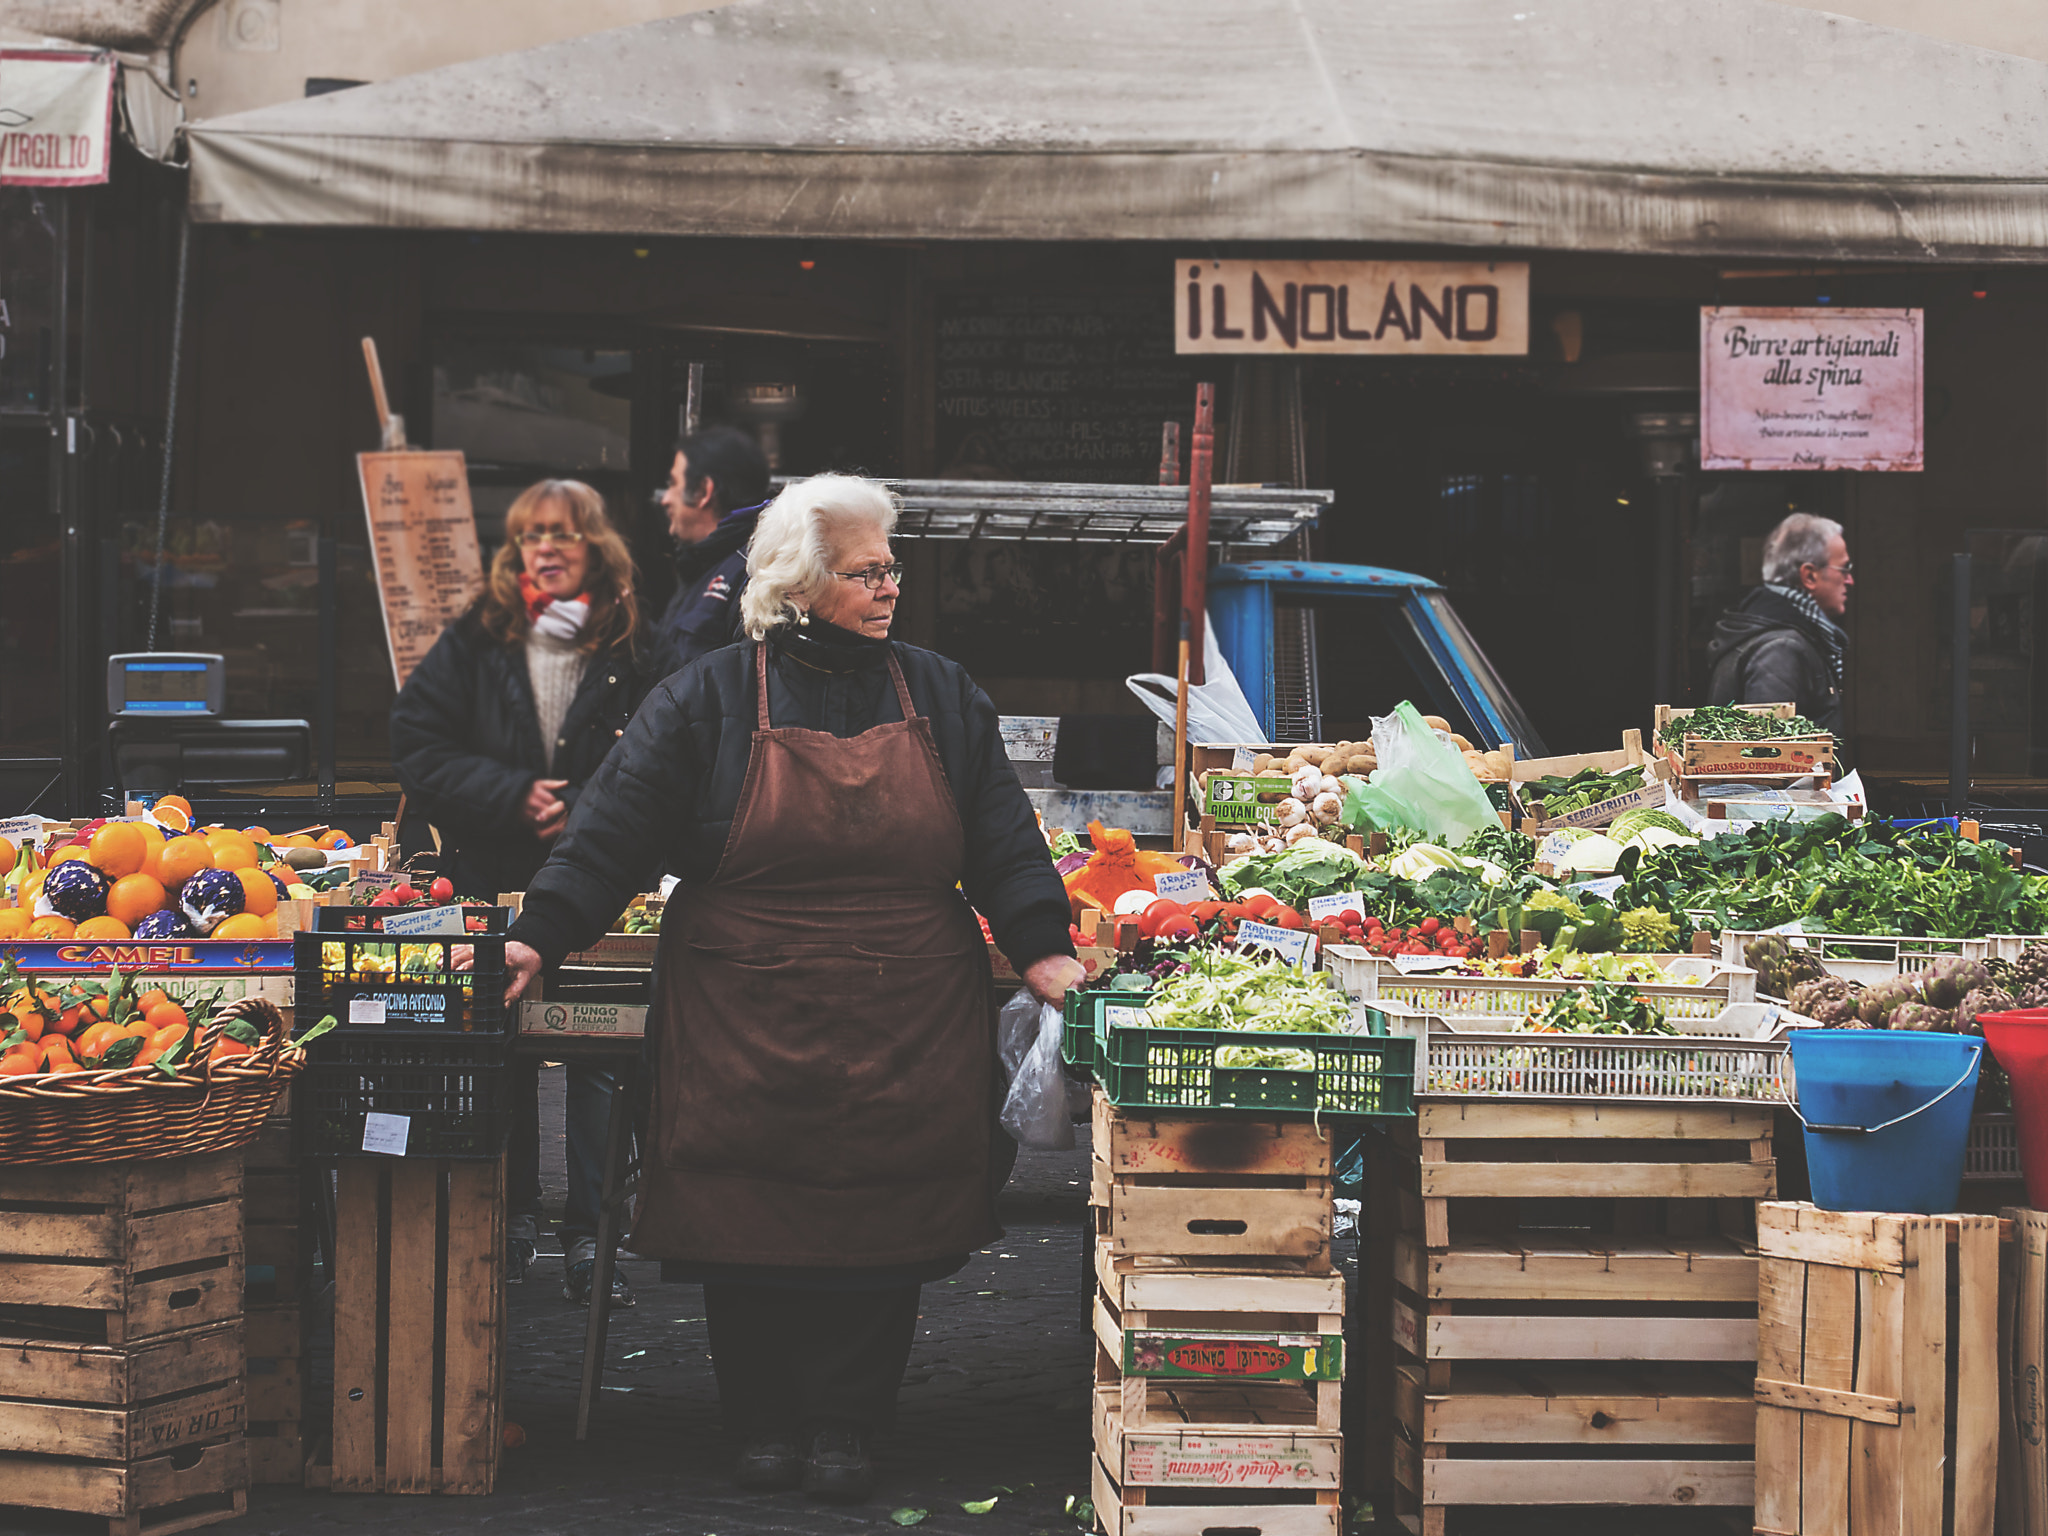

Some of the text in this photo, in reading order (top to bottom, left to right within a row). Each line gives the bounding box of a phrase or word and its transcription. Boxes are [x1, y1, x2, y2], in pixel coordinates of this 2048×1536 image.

[1251, 270, 1499, 349] NOLANO
[1725, 326, 1900, 361] Birre artigianali
[1763, 359, 1862, 395] alla spina
[1694, 761, 1746, 775] INGROSSO
[1566, 792, 1642, 824] SERRAFRUTTA
[1245, 922, 1295, 937] RADICCHIO
[57, 945, 204, 965] CAMEL
[409, 993, 446, 1012] ANTONIO
[573, 1006, 618, 1017] FUNGO
[572, 1016, 618, 1025] ITALIANO
[572, 1024, 617, 1032] CERTIFICATO
[1174, 1349, 1225, 1367] DANIELE
[1166, 1461, 1233, 1485] Giovanni
